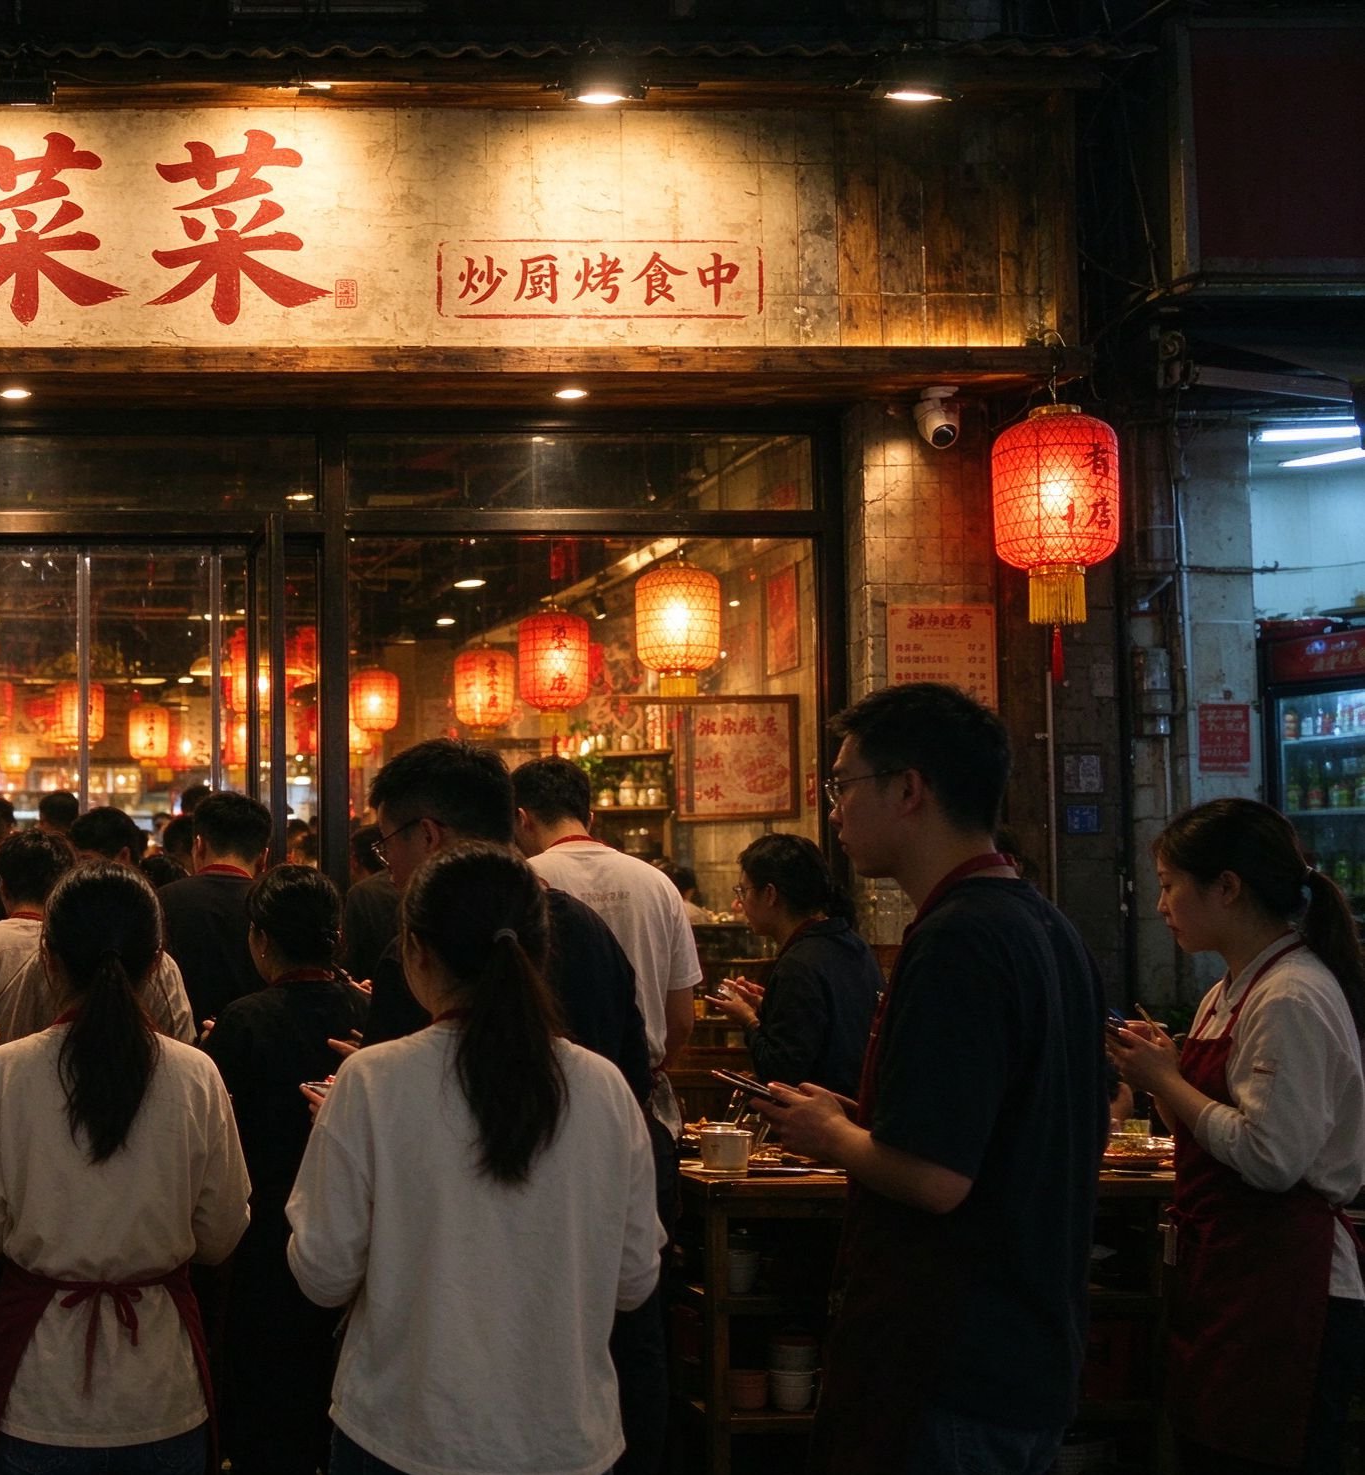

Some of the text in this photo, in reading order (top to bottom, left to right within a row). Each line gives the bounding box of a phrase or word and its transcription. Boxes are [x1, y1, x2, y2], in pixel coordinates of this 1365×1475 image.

[458, 250, 741, 307] 炒厨烤食中
